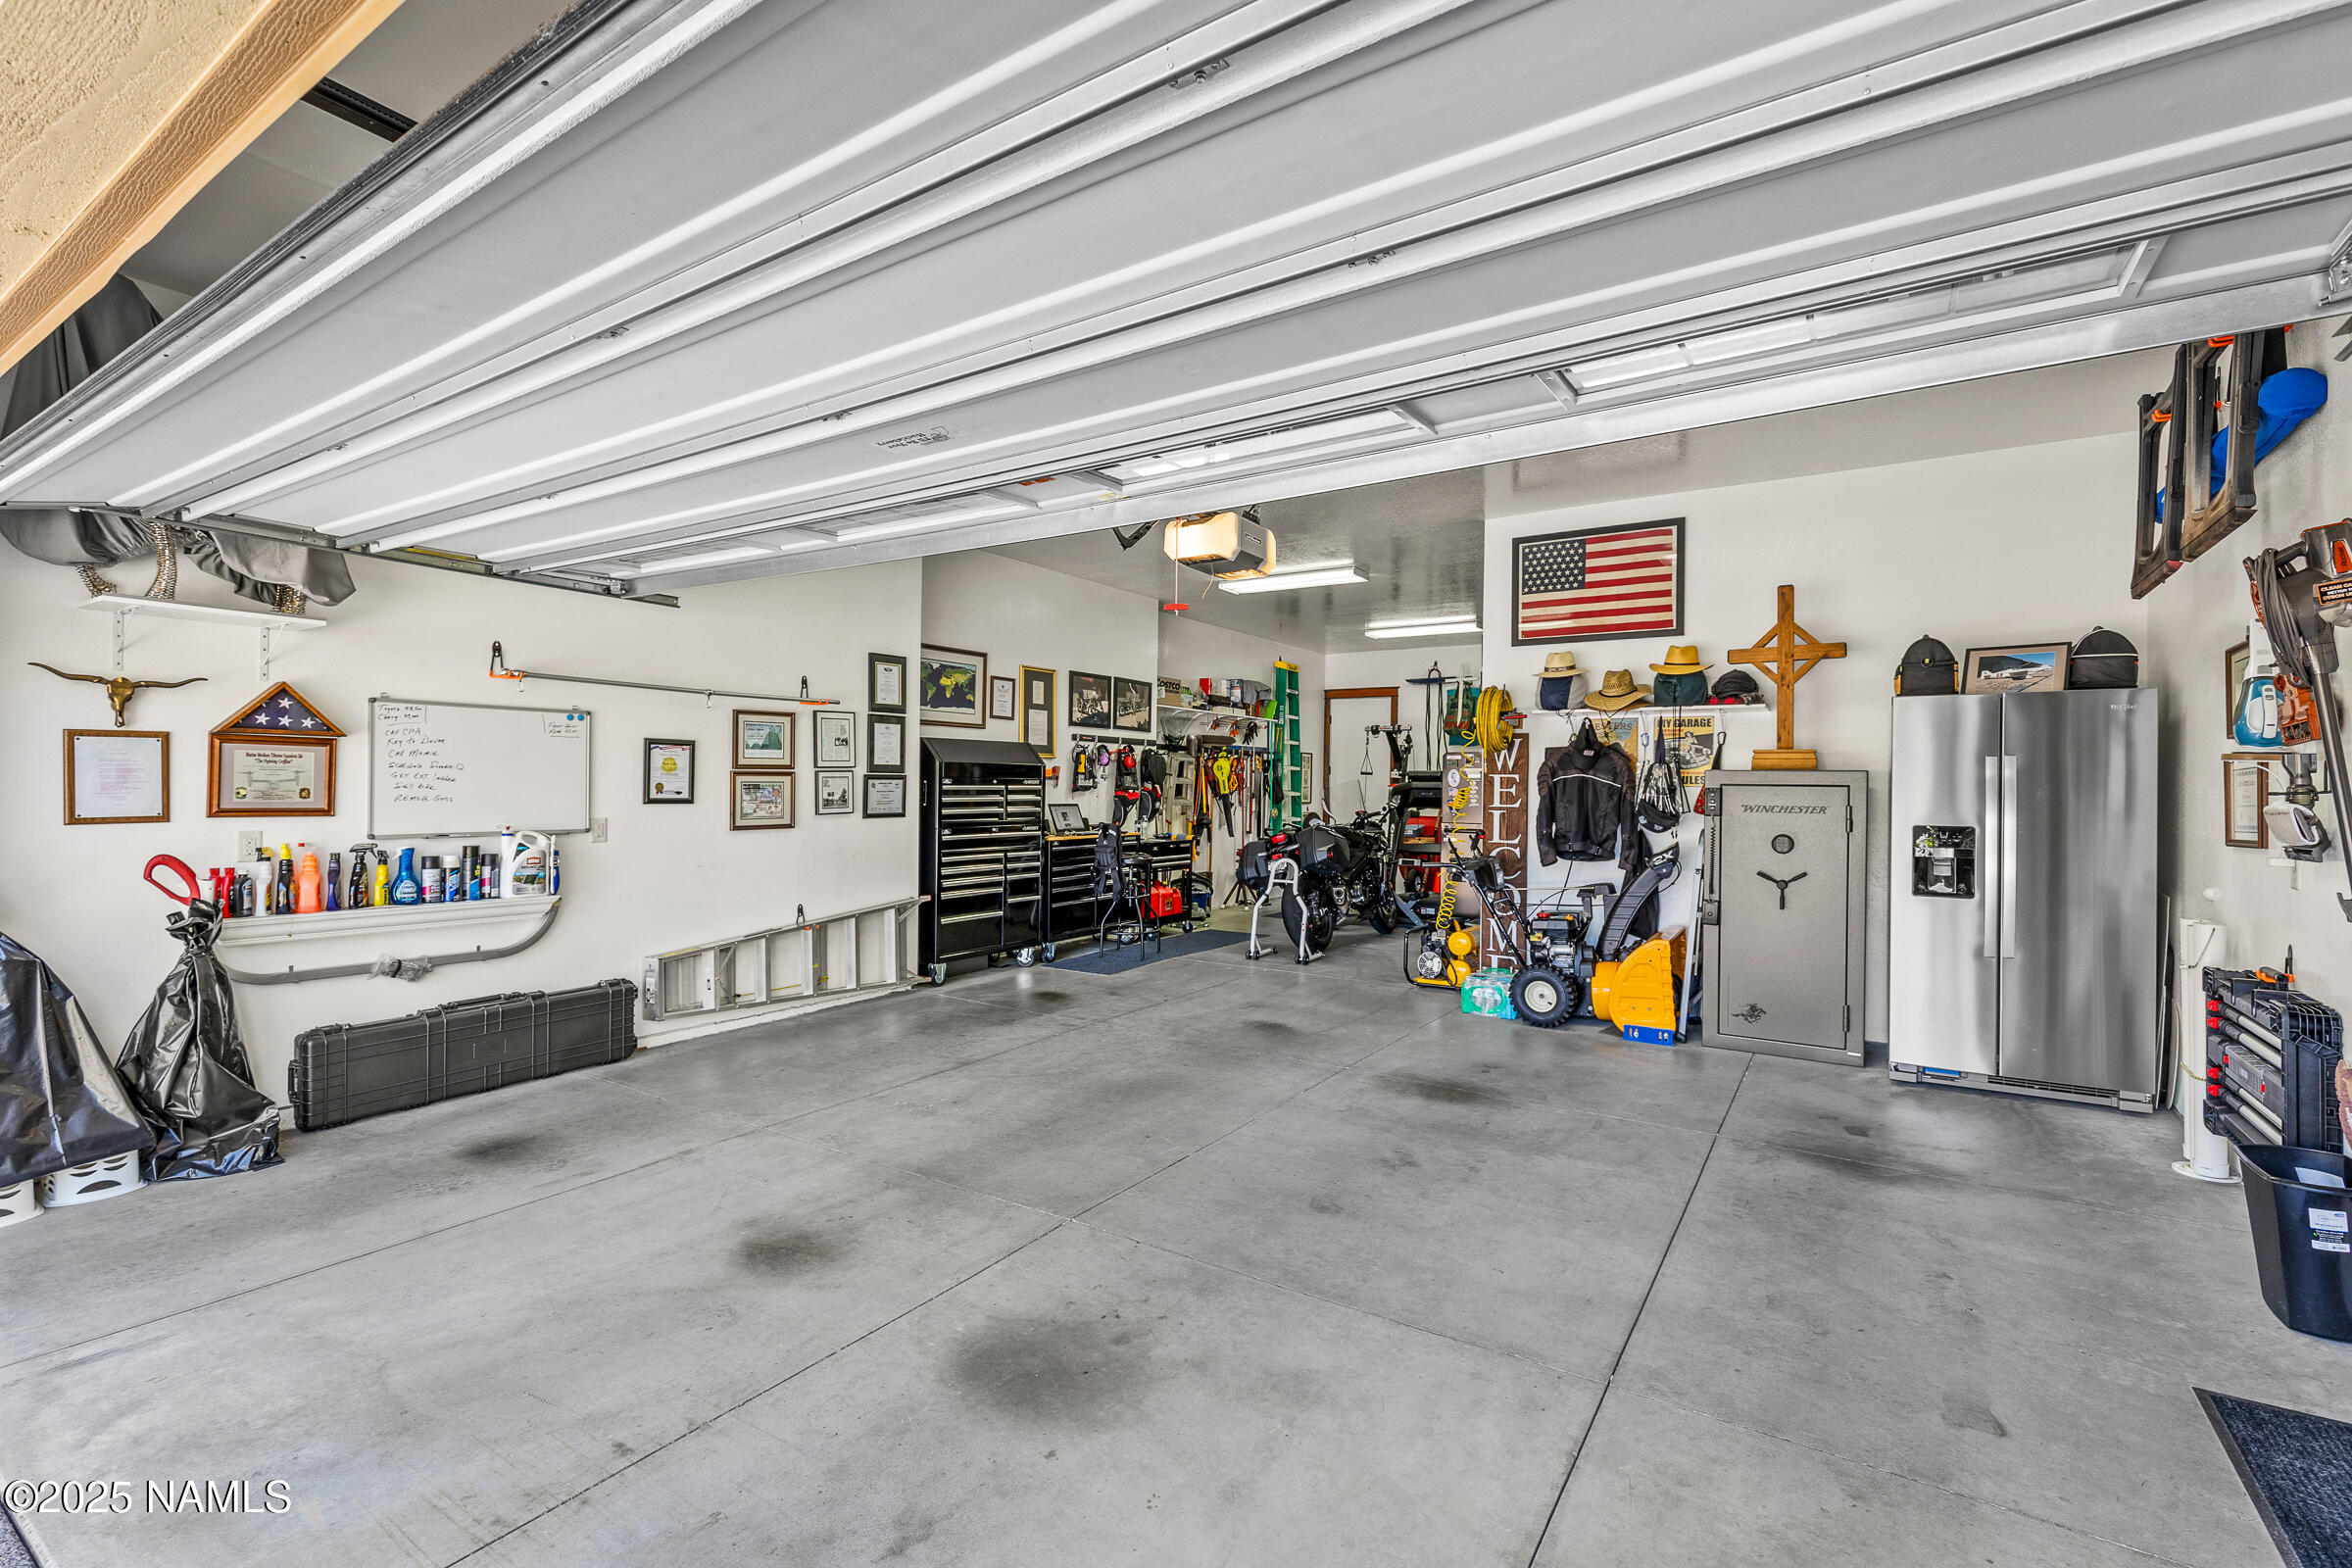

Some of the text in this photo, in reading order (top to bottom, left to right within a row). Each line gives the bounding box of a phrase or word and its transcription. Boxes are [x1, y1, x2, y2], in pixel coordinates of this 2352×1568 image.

[1674, 717, 1712, 728] GARAGE
[1682, 775, 1705, 785] ULES
[1740, 804, 1829, 815] WINCHESTER
